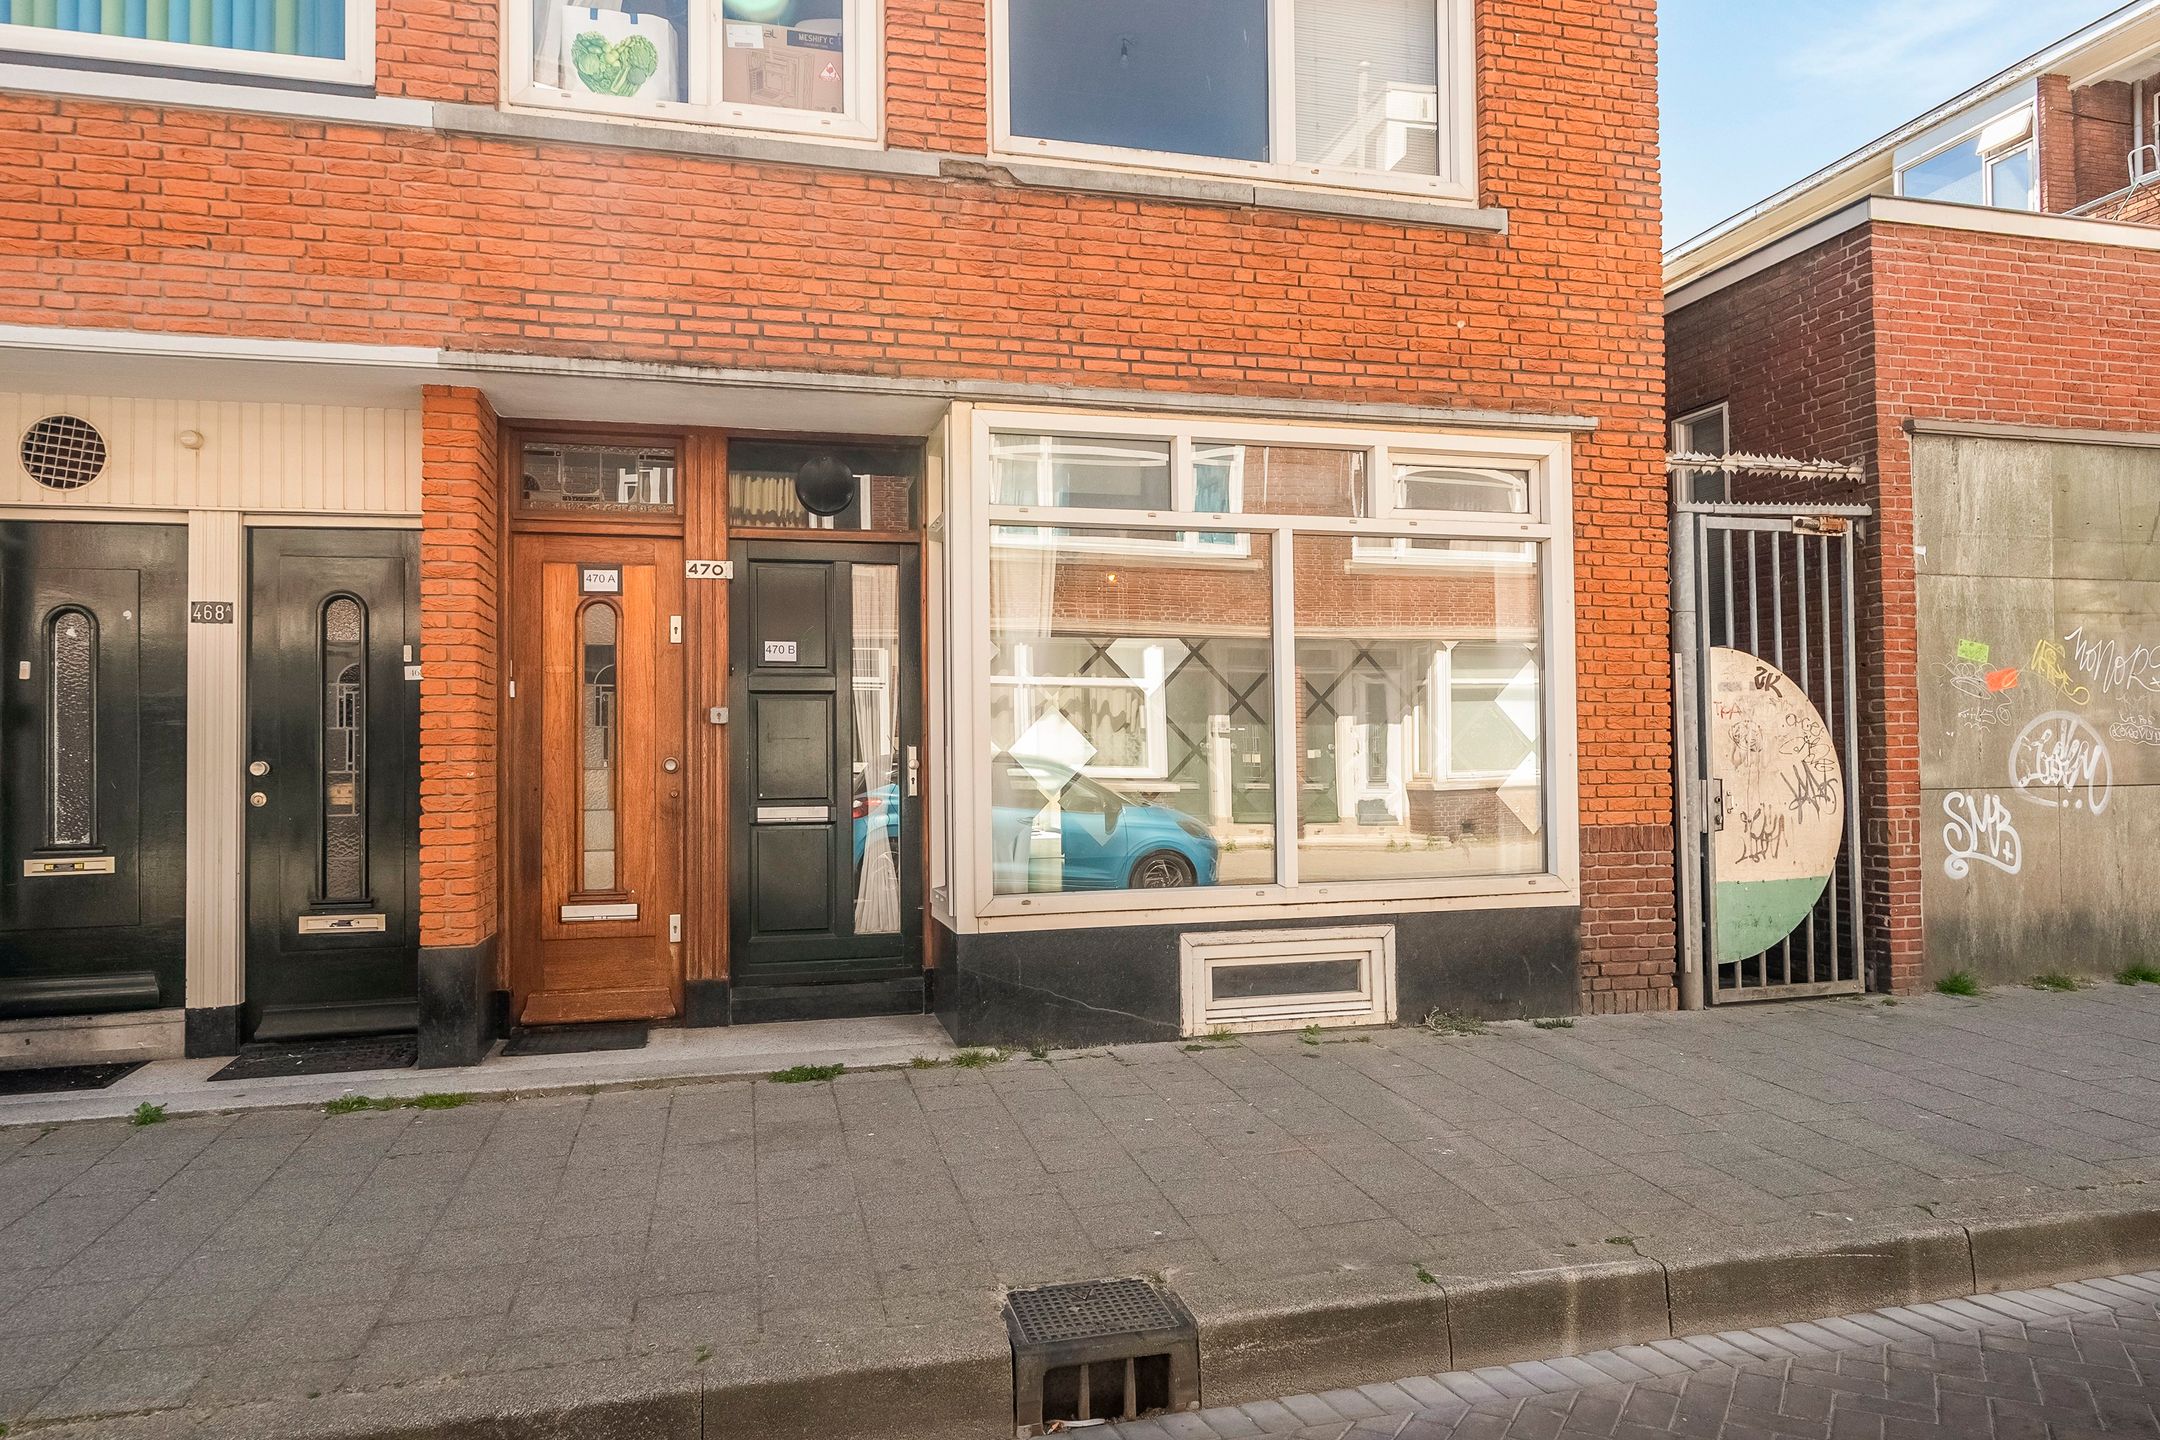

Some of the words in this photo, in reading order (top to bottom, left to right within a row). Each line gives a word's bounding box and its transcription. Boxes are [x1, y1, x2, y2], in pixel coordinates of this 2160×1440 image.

[798, 33, 827, 44] MESHIFY
[829, 37, 834, 45] C
[687, 563, 724, 576] 470
[586, 574, 605, 583] 470
[607, 574, 616, 583] A
[766, 645, 785, 654] 470
[788, 645, 796, 654] B
